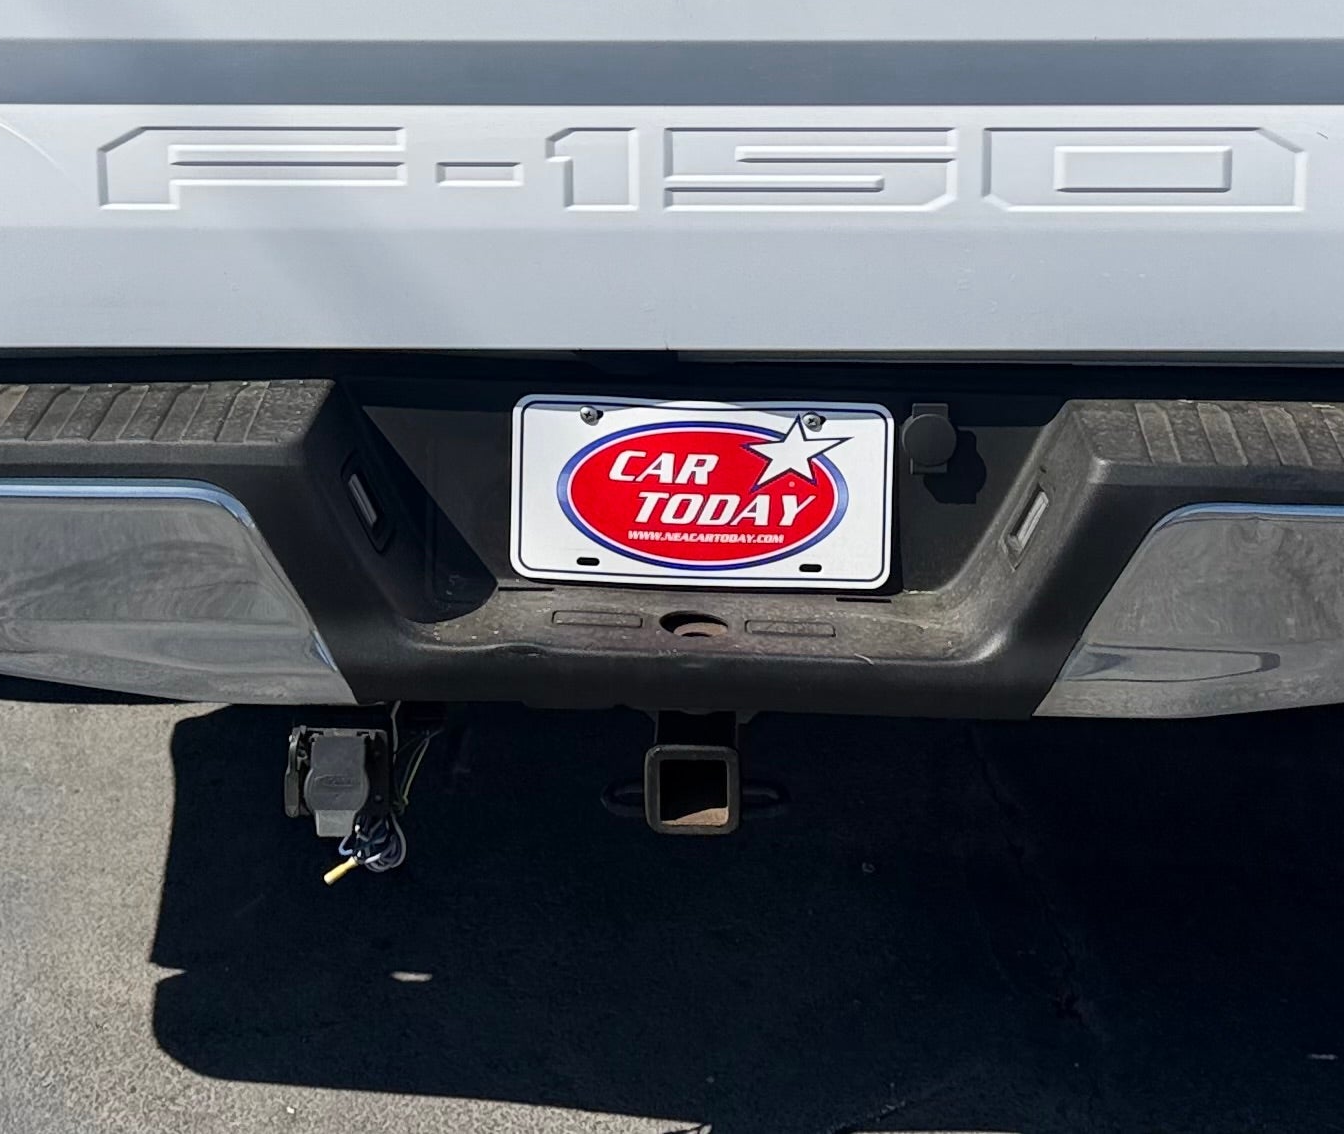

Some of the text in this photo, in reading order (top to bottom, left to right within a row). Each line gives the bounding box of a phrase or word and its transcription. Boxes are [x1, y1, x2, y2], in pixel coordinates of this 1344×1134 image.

[99, 126, 1306, 211] F-150
[609, 450, 719, 486] CAR
[634, 492, 816, 527] TODAY
[627, 530, 784, 544] WWW.NEACARTODAY.COM
